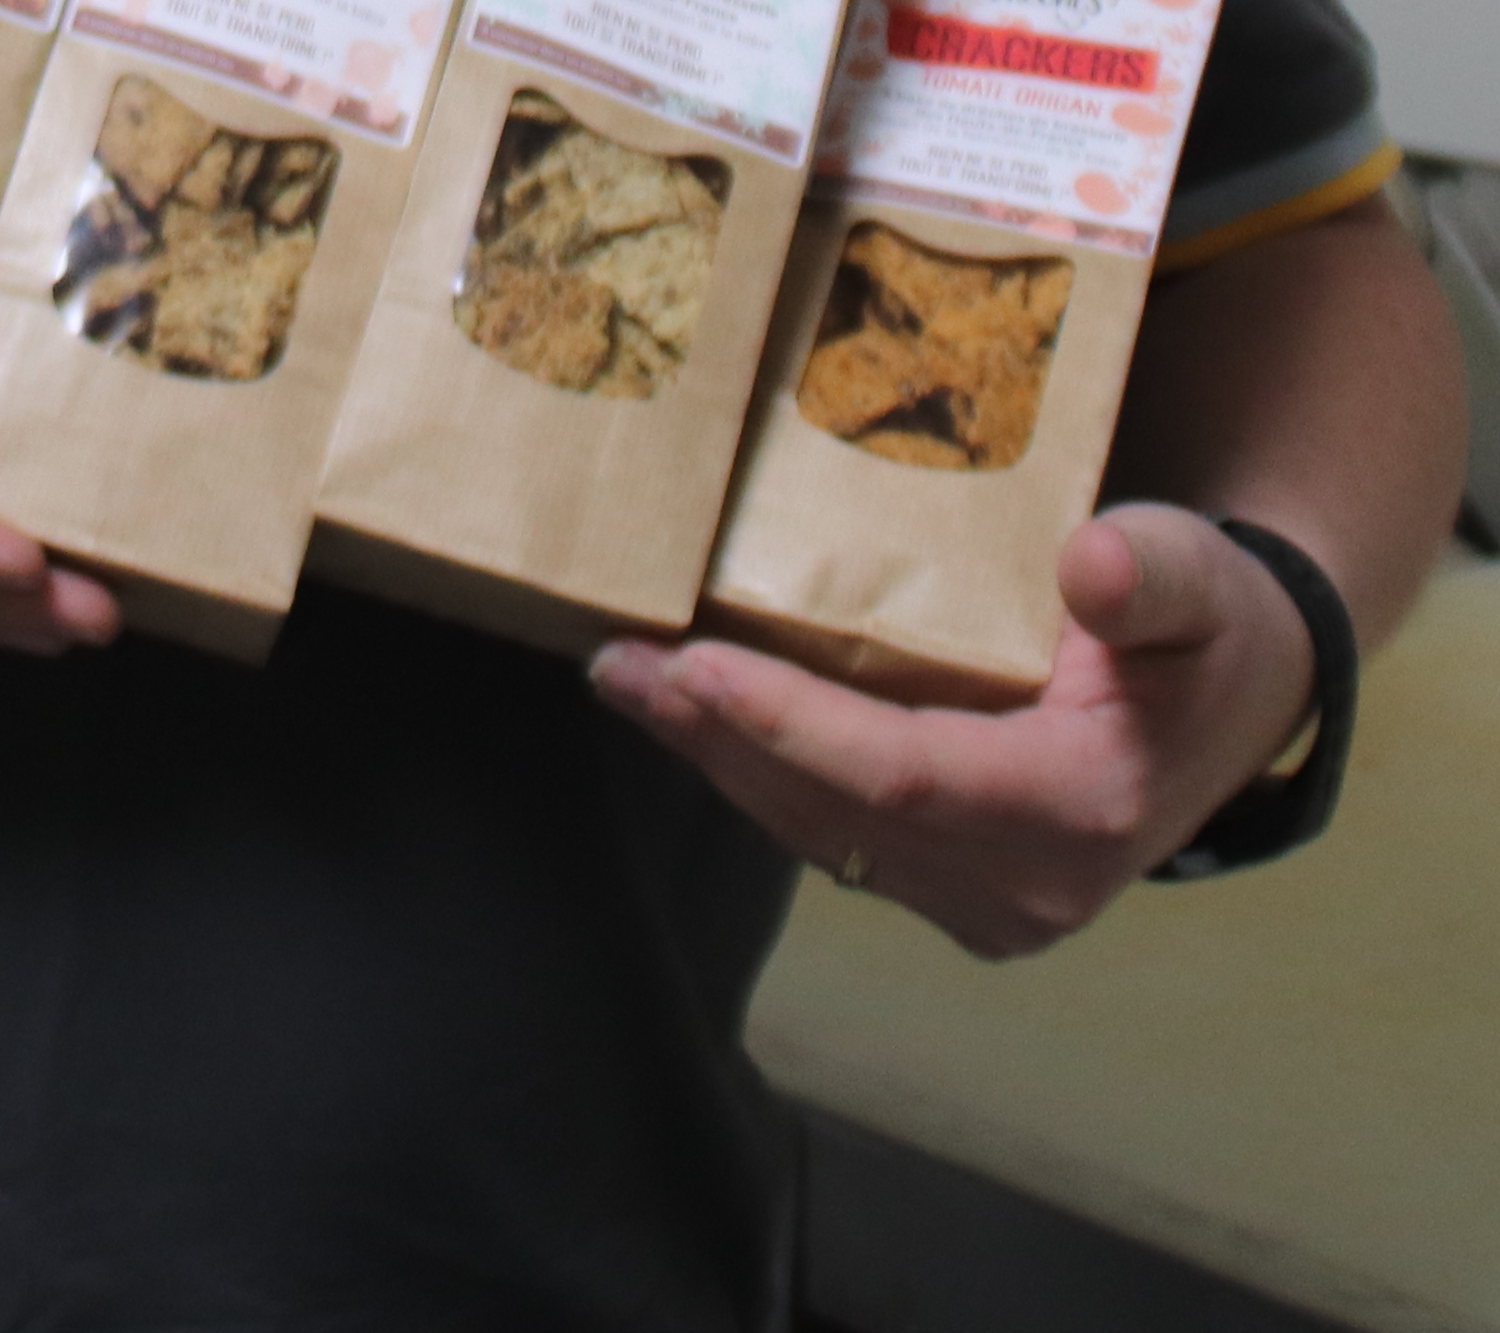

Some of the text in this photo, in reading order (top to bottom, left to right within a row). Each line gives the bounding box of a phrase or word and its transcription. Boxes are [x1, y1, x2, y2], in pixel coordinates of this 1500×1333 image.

[910, 17, 1148, 89] CRACKERS
[921, 67, 1103, 119] TOMATE ORIGAN
